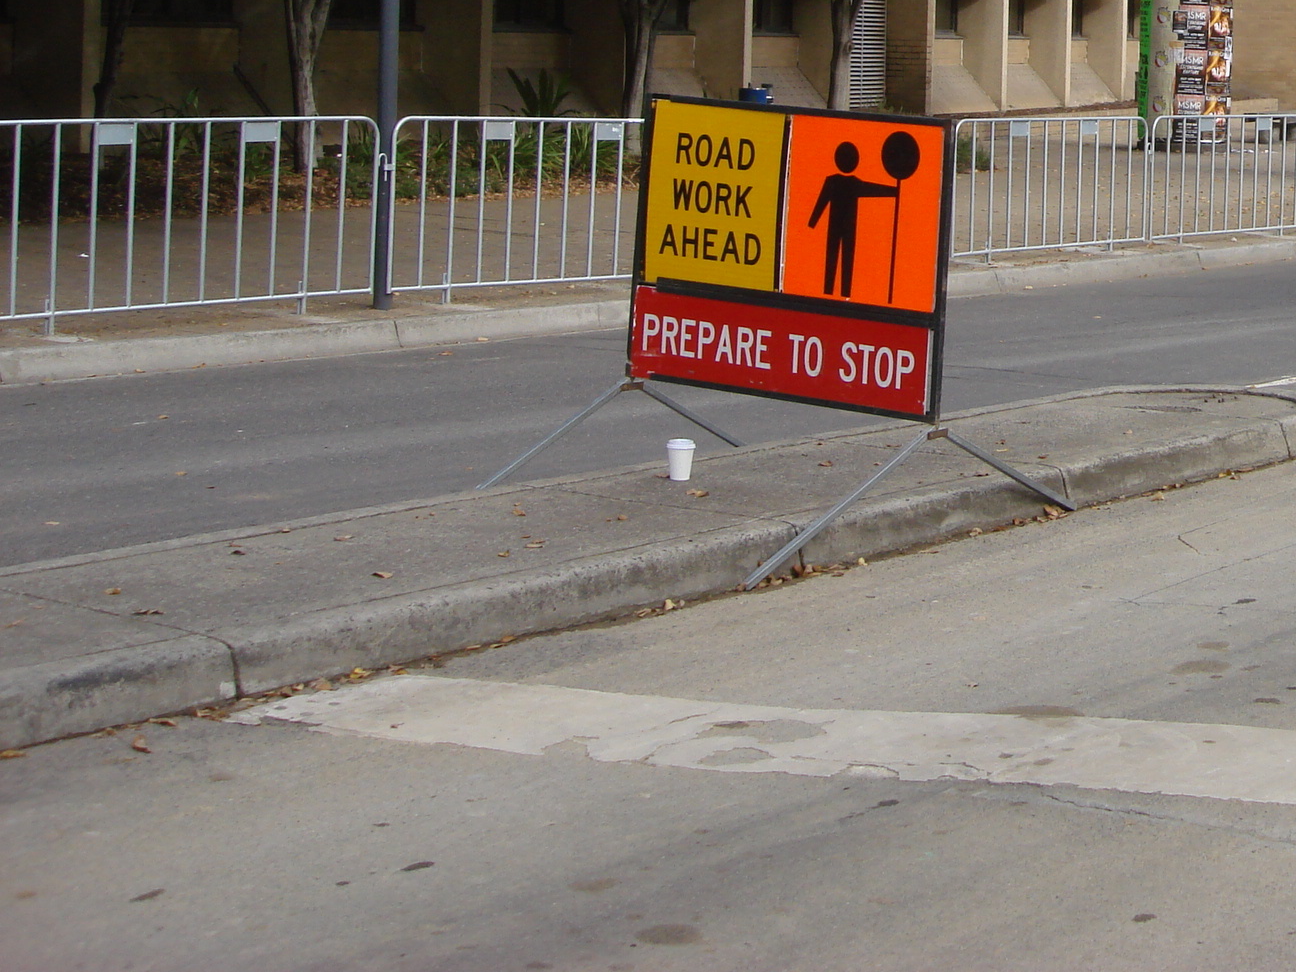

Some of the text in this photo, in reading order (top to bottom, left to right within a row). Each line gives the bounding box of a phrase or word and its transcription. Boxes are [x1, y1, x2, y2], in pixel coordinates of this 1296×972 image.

[675, 132, 755, 171] ROAD
[673, 178, 752, 218] WORK
[658, 224, 761, 266] AHEAD
[642, 313, 915, 390] PREPARE TO STOP
